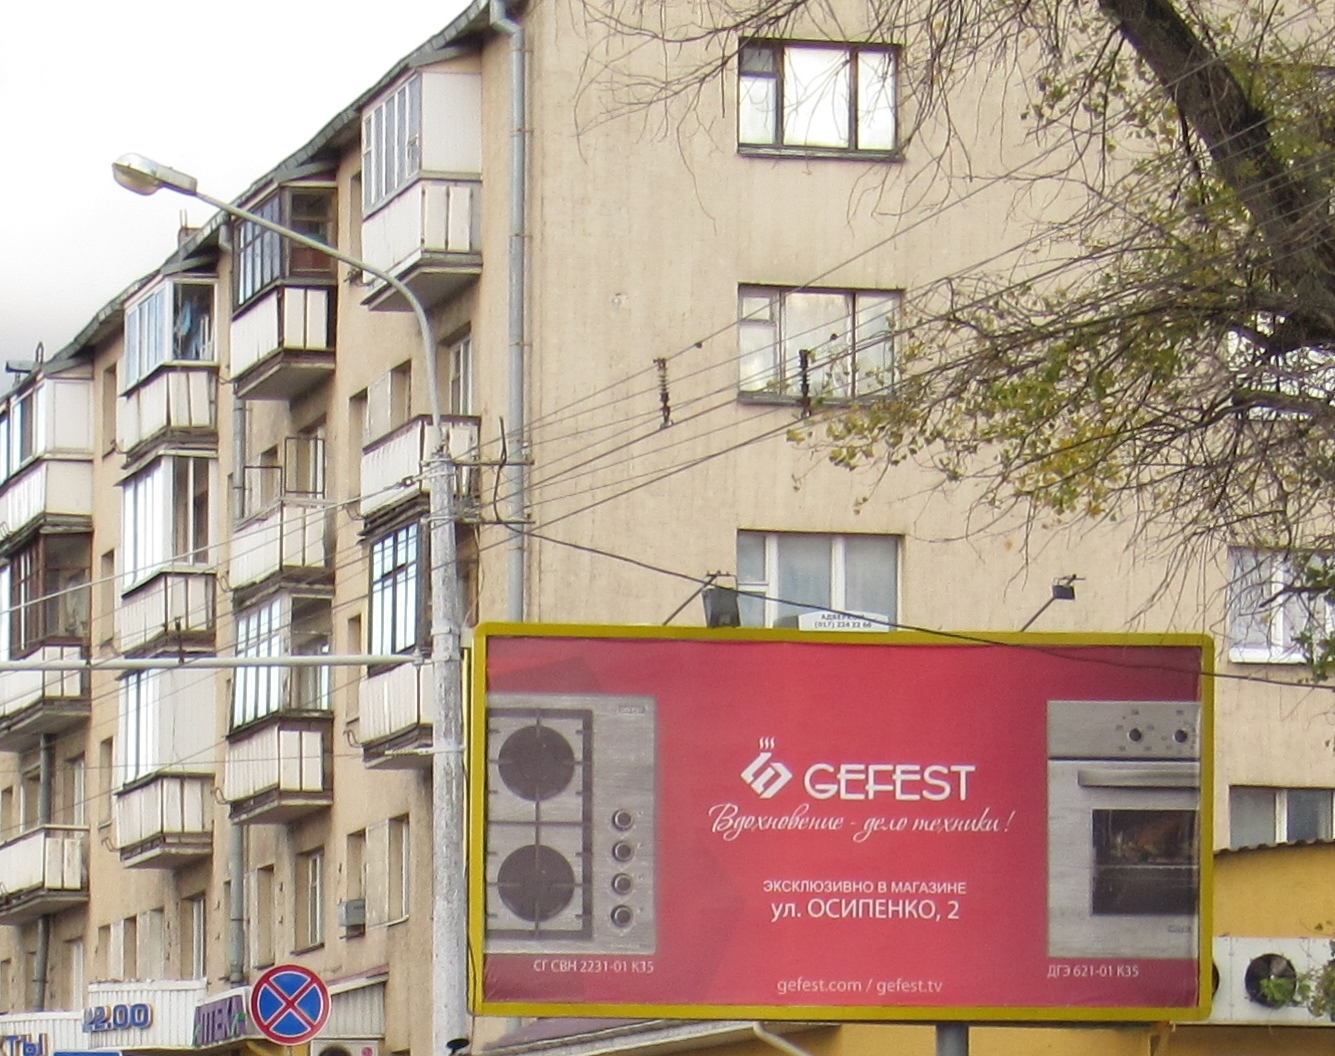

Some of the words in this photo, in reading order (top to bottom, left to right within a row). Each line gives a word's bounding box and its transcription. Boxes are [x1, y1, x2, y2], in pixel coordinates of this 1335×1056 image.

[804, 763, 977, 801] GEFEST
[708, 802, 844, 842] Вдохновение
[852, 816, 908, 843] дело
[763, 880, 874, 894] ЭКСКЛЮЗИВНО
[877, 882, 887, 893] В
[891, 882, 967, 895] МАГАЗИНЕ
[770, 902, 802, 923] ул.
[807, 898, 941, 922] ОСИПЕНКО,
[947, 900, 960, 920] 2
[579, 960, 627, 974] 2231-01
[1047, 964, 1071, 979] ДГЭ
[1073, 965, 1113, 977] 621-01
[777, 976, 862, 995] gefest.com
[876, 978, 943, 996] gefest.tv
